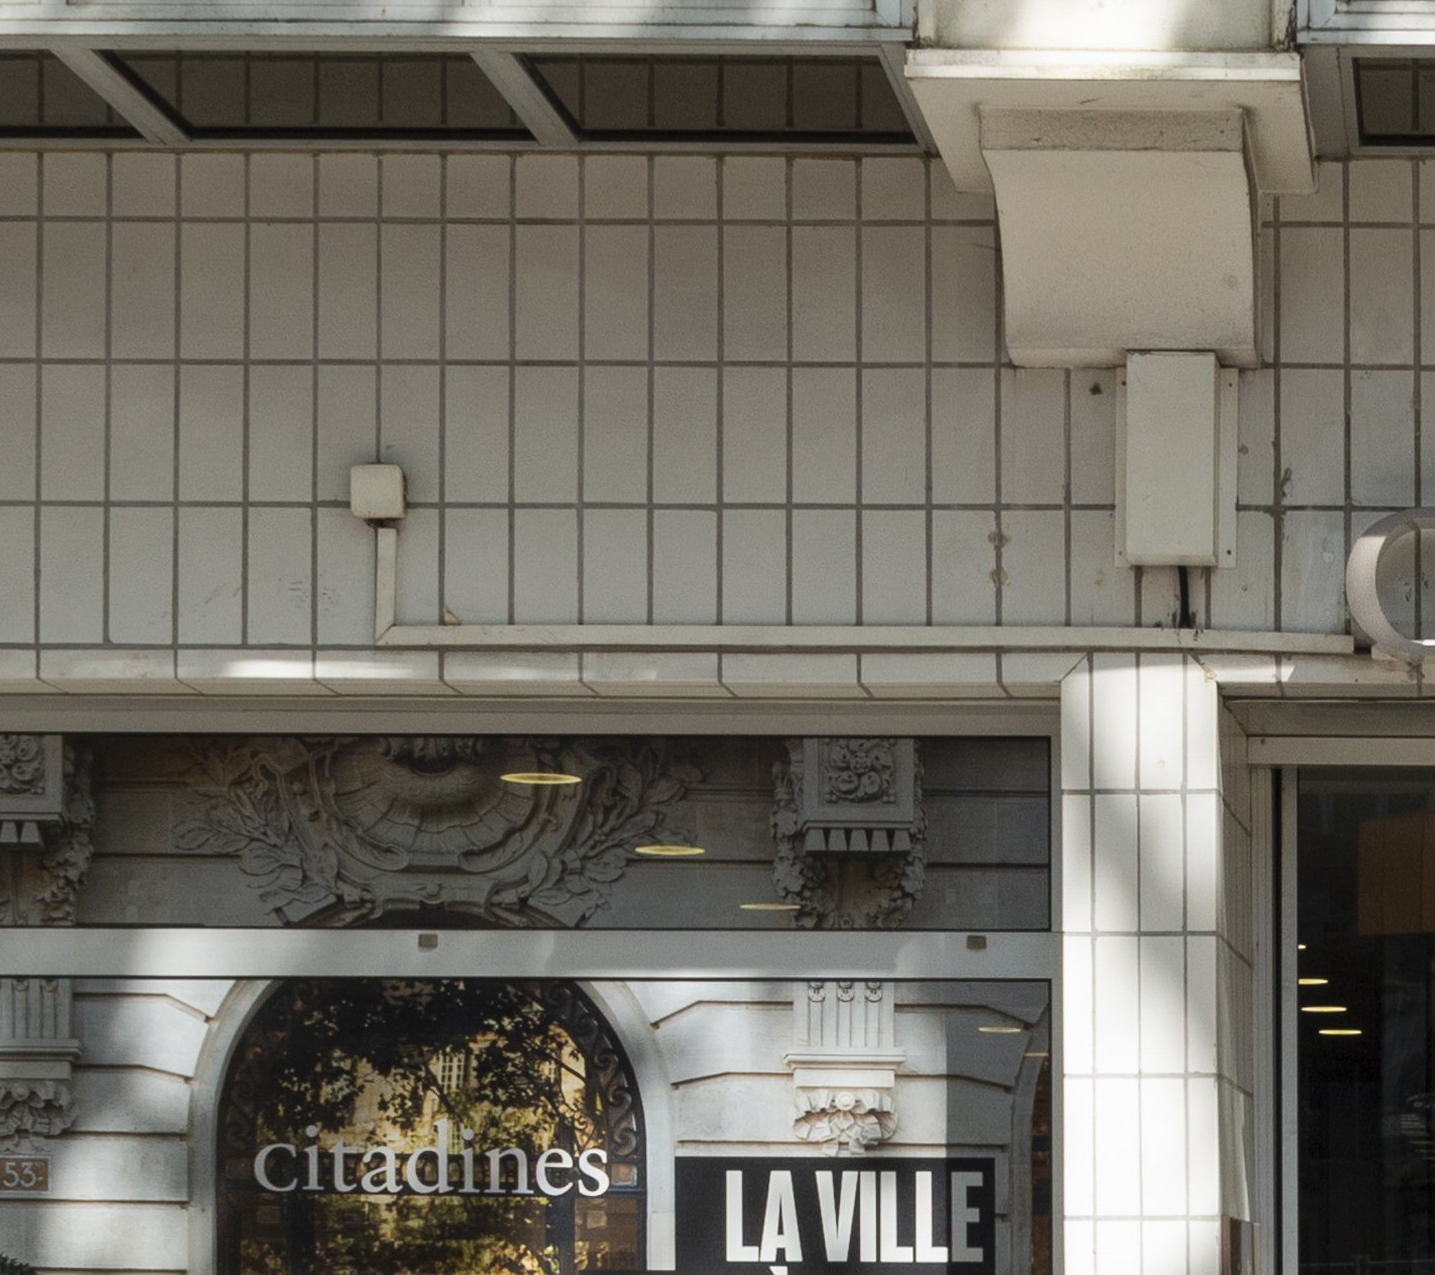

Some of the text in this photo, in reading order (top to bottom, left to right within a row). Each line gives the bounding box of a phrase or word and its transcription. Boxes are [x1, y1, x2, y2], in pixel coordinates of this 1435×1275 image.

[2, 1162, 37, 1188] 53
[254, 1119, 611, 1197] citadines
[726, 1170, 984, 1263] LA VILLE
